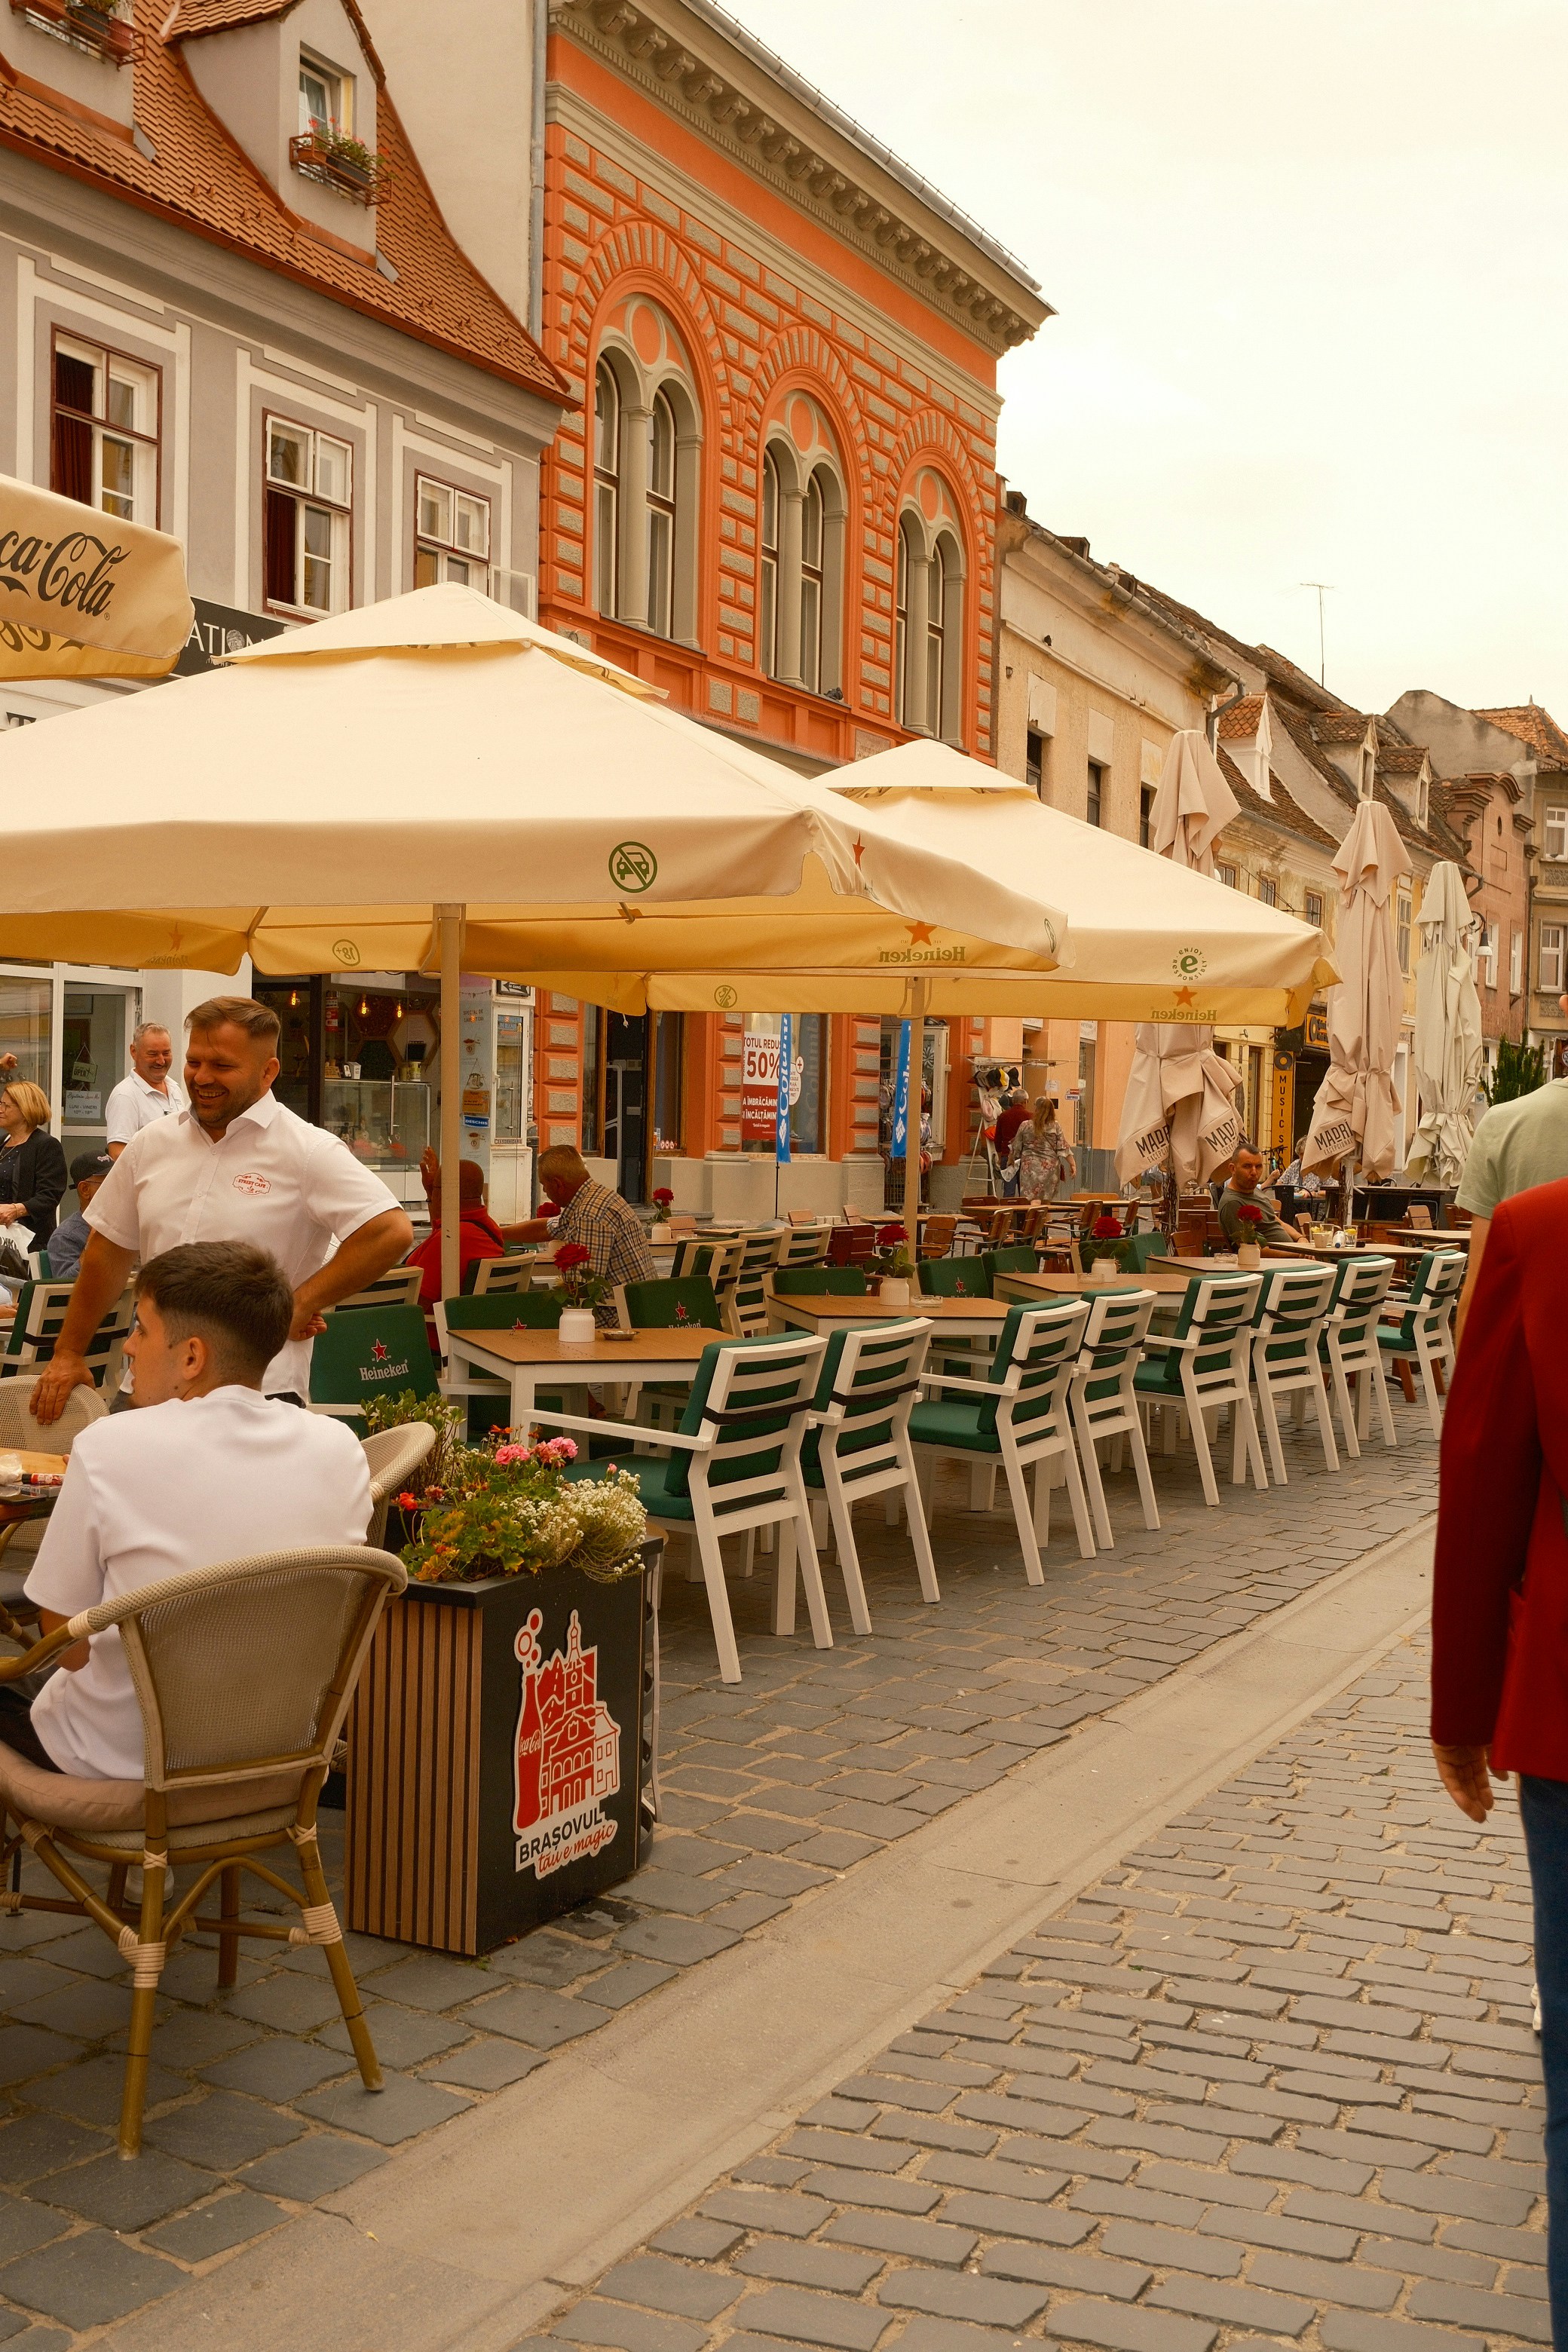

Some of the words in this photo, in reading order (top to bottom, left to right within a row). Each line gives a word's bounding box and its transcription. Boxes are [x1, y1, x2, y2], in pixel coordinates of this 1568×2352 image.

[764, 1039, 781, 1049] REDU
[747, 1051, 780, 1079] 50%
[1314, 1119, 1353, 1150] MADRÍ
[359, 1364, 409, 1381] Heineken
[519, 1808, 602, 1864] BRAȘOVUL
[563, 1845, 573, 1859] e
[574, 1824, 615, 1850] magic
